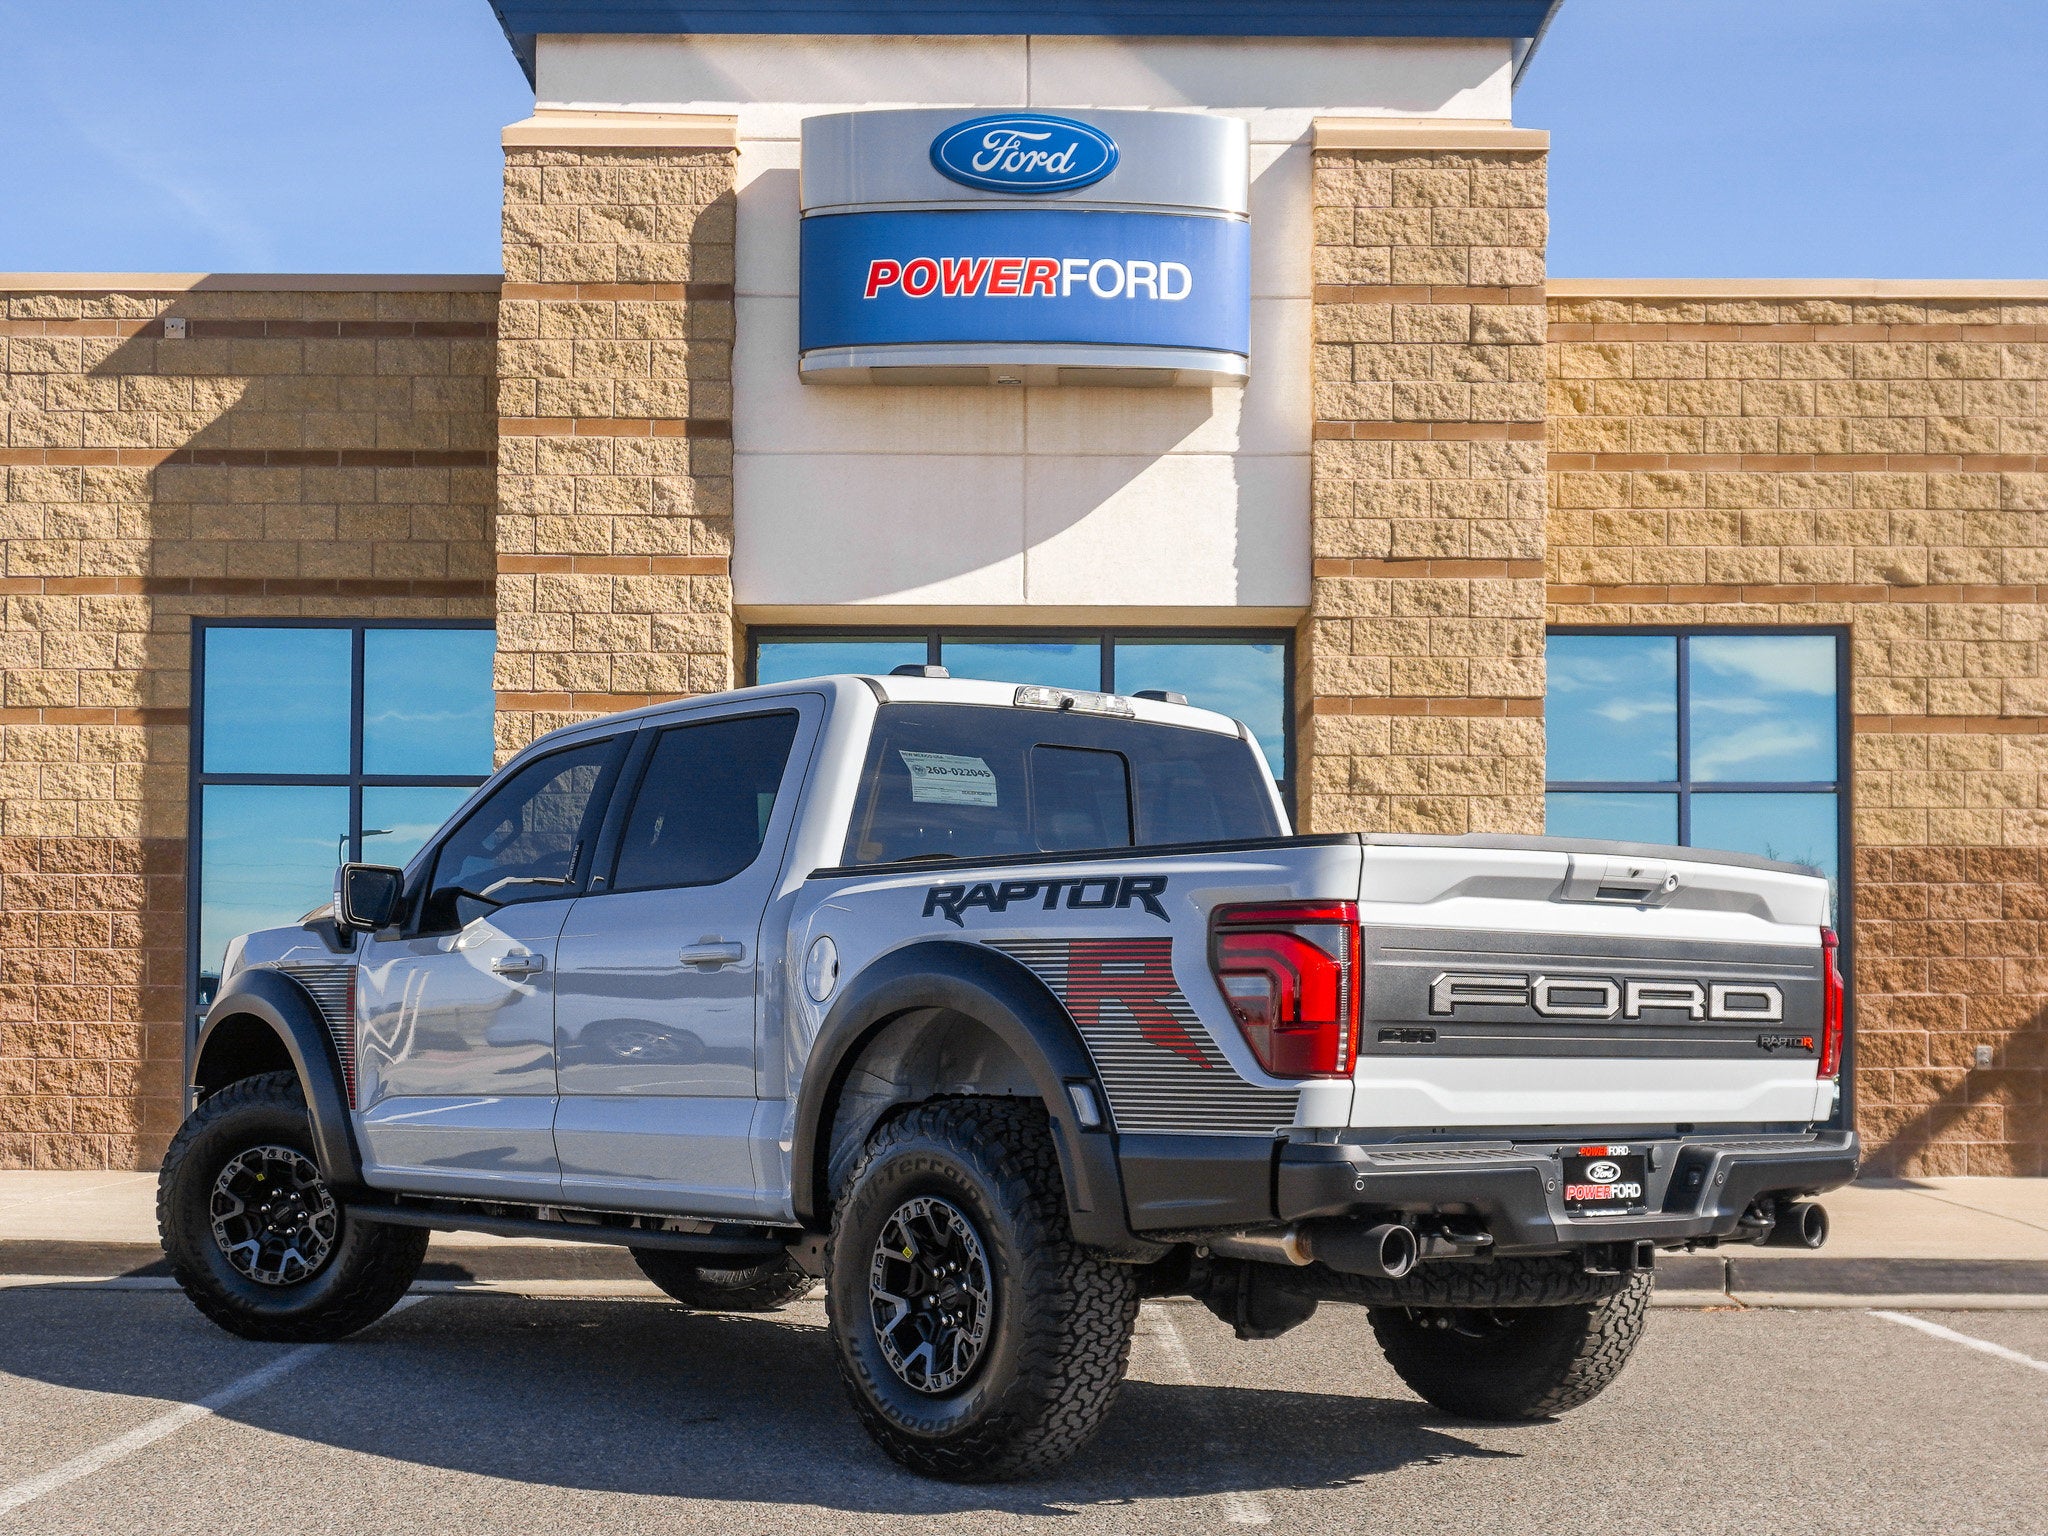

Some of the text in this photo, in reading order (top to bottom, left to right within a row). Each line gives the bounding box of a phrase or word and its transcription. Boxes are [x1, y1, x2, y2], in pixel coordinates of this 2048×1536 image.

[971, 129, 1079, 175] Ford
[863, 257, 1194, 301] POWERFORD
[926, 766, 991, 778] 26D-022045
[922, 875, 1171, 928] RAPTOR
[1429, 971, 1785, 1023] FORD
[1757, 1034, 1814, 1053] RAPTOR
[1594, 1164, 1615, 1179] Ford
[1565, 1183, 1642, 1200] POWERFORD
